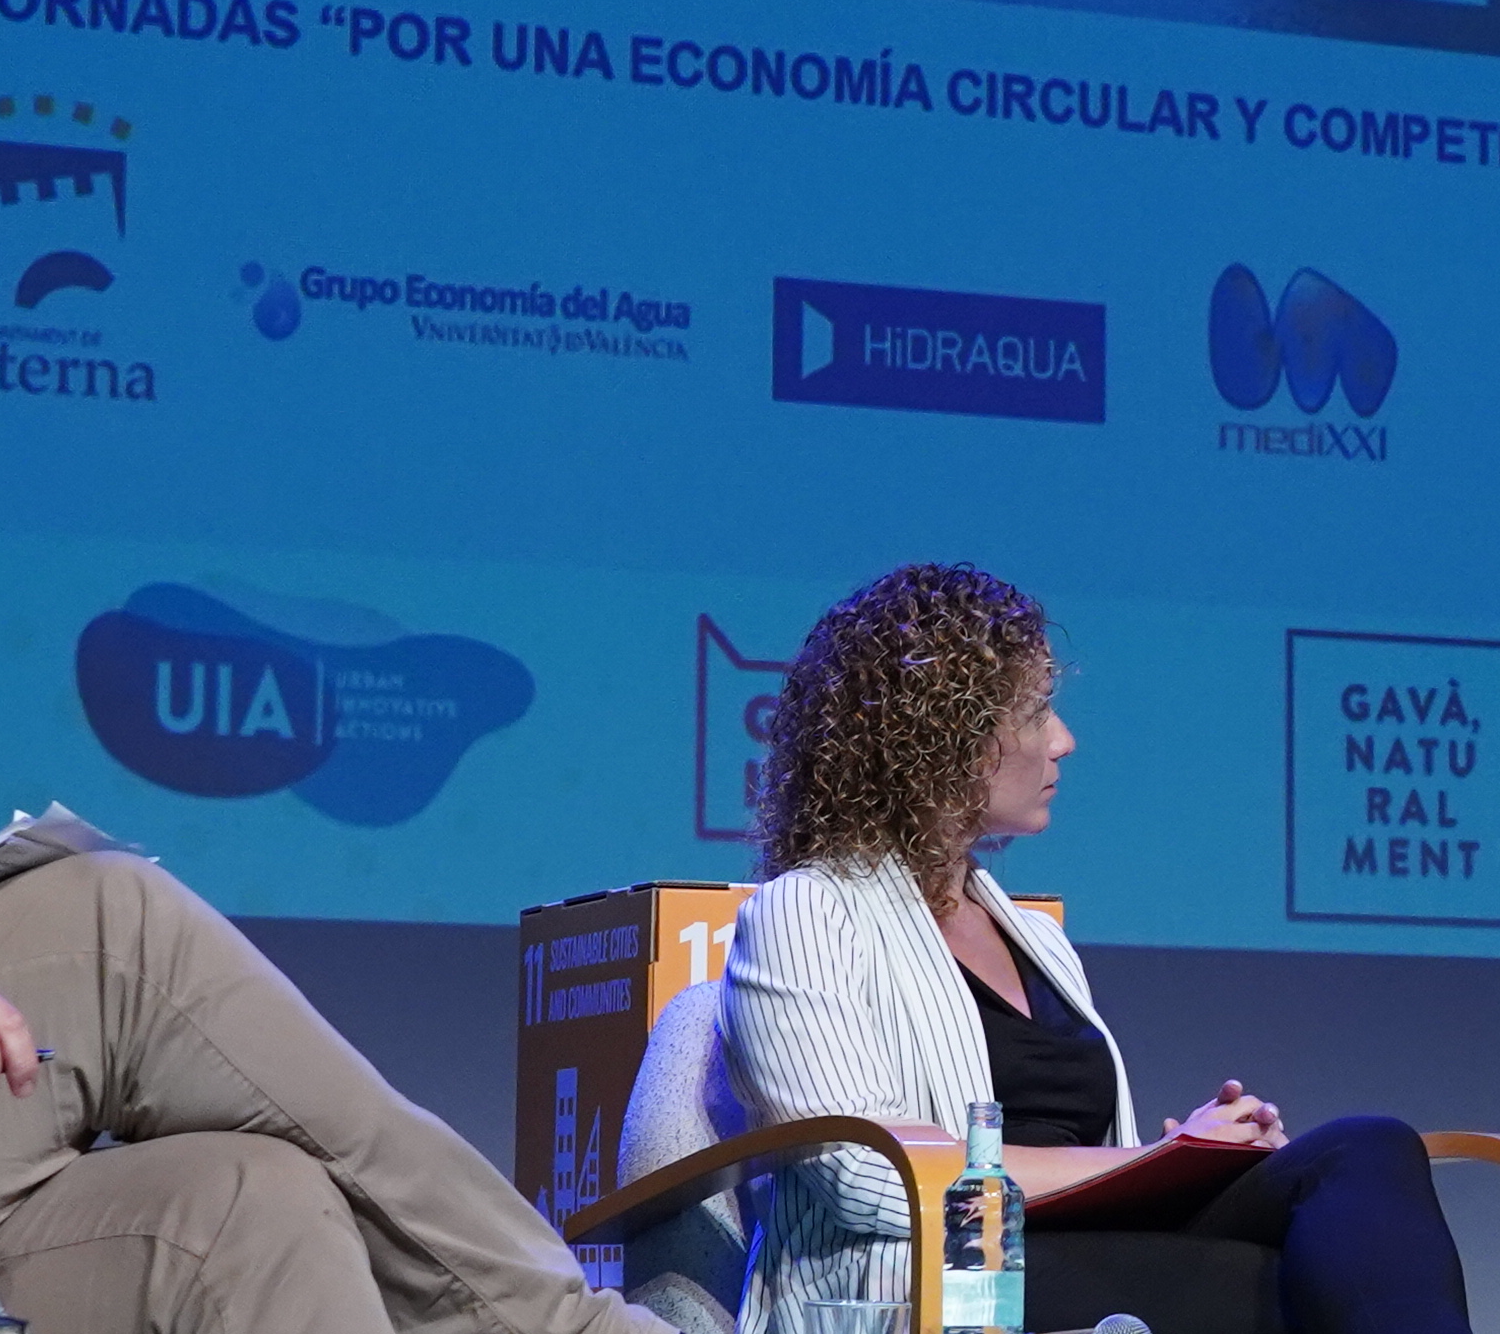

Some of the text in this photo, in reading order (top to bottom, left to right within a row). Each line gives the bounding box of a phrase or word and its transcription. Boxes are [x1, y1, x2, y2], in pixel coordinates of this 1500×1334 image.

[492, 19, 615, 82] UNA
[627, 33, 934, 113] ECONOMÍA
[945, 67, 1219, 142] CIRCULAR
[1236, 95, 1269, 144] Y
[300, 265, 692, 334] Grupo Economía del Agua
[1217, 417, 1388, 463] mediXXI
[155, 660, 296, 741] UIA
[1344, 733, 1477, 779] NATU
[1366, 787, 1457, 829] RAL
[1342, 836, 1482, 881] MENT
[524, 923, 639, 1027] 11 SUSTAINABLE CITIES
[548, 977, 632, 1021] AND COMMUNITIES
